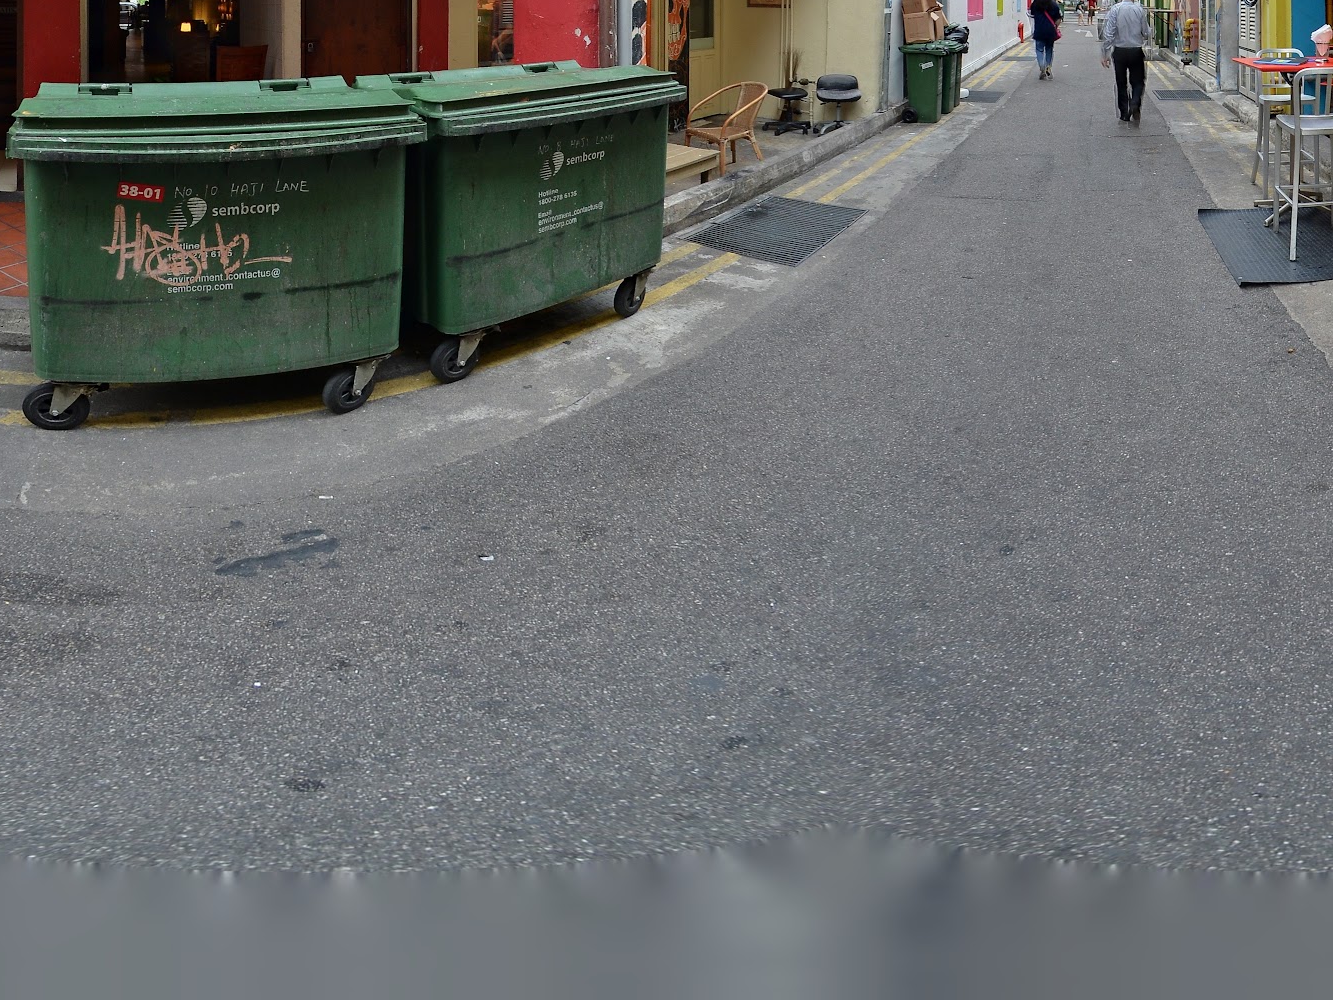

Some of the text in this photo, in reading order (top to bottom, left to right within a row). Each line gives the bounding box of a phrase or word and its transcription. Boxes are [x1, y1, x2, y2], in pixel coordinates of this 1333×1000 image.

[566, 150, 605, 166] sembcorp
[119, 184, 162, 200] 38-01
[204, 184, 218, 199] 10
[230, 182, 264, 197] HAJI
[275, 178, 310, 193] LANE
[538, 188, 559, 198] Hotline
[212, 201, 280, 218] sembcorp
[538, 209, 553, 219] Email
[538, 217, 578, 234] sembcorp.com
[167, 282, 234, 294] sembcorp.com
